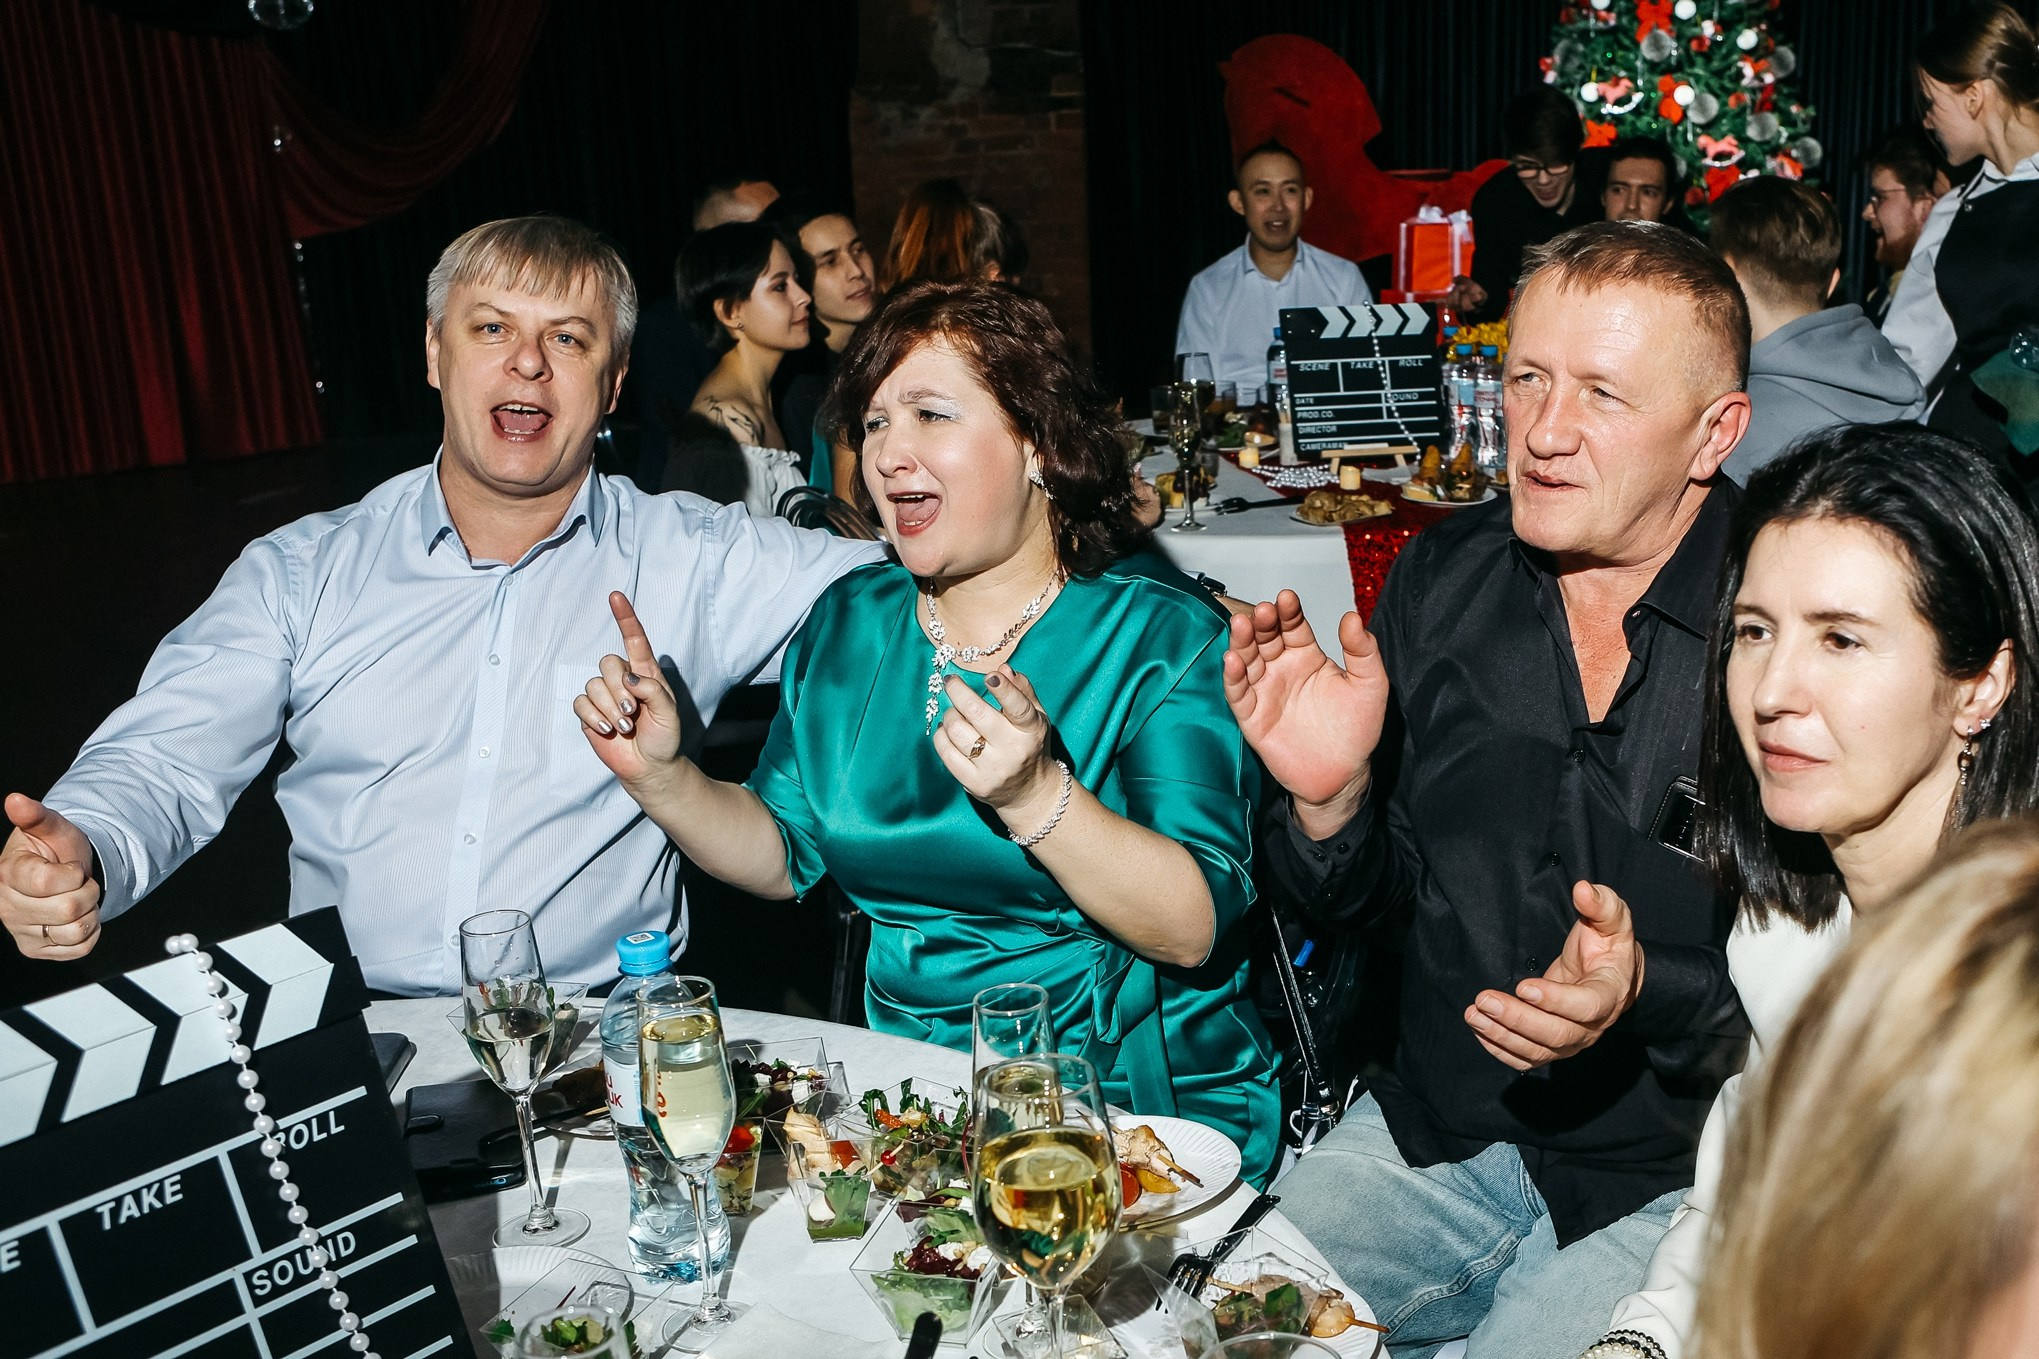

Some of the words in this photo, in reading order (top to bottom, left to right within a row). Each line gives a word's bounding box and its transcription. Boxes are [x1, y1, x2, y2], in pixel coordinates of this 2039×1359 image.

[1299, 362, 1330, 371] SCENE
[1350, 361, 1374, 369] TAKE
[1399, 359, 1423, 367] ROLL
[1298, 425, 1337, 434] DIRECTOR
[95, 1174, 184, 1231] TAKE
